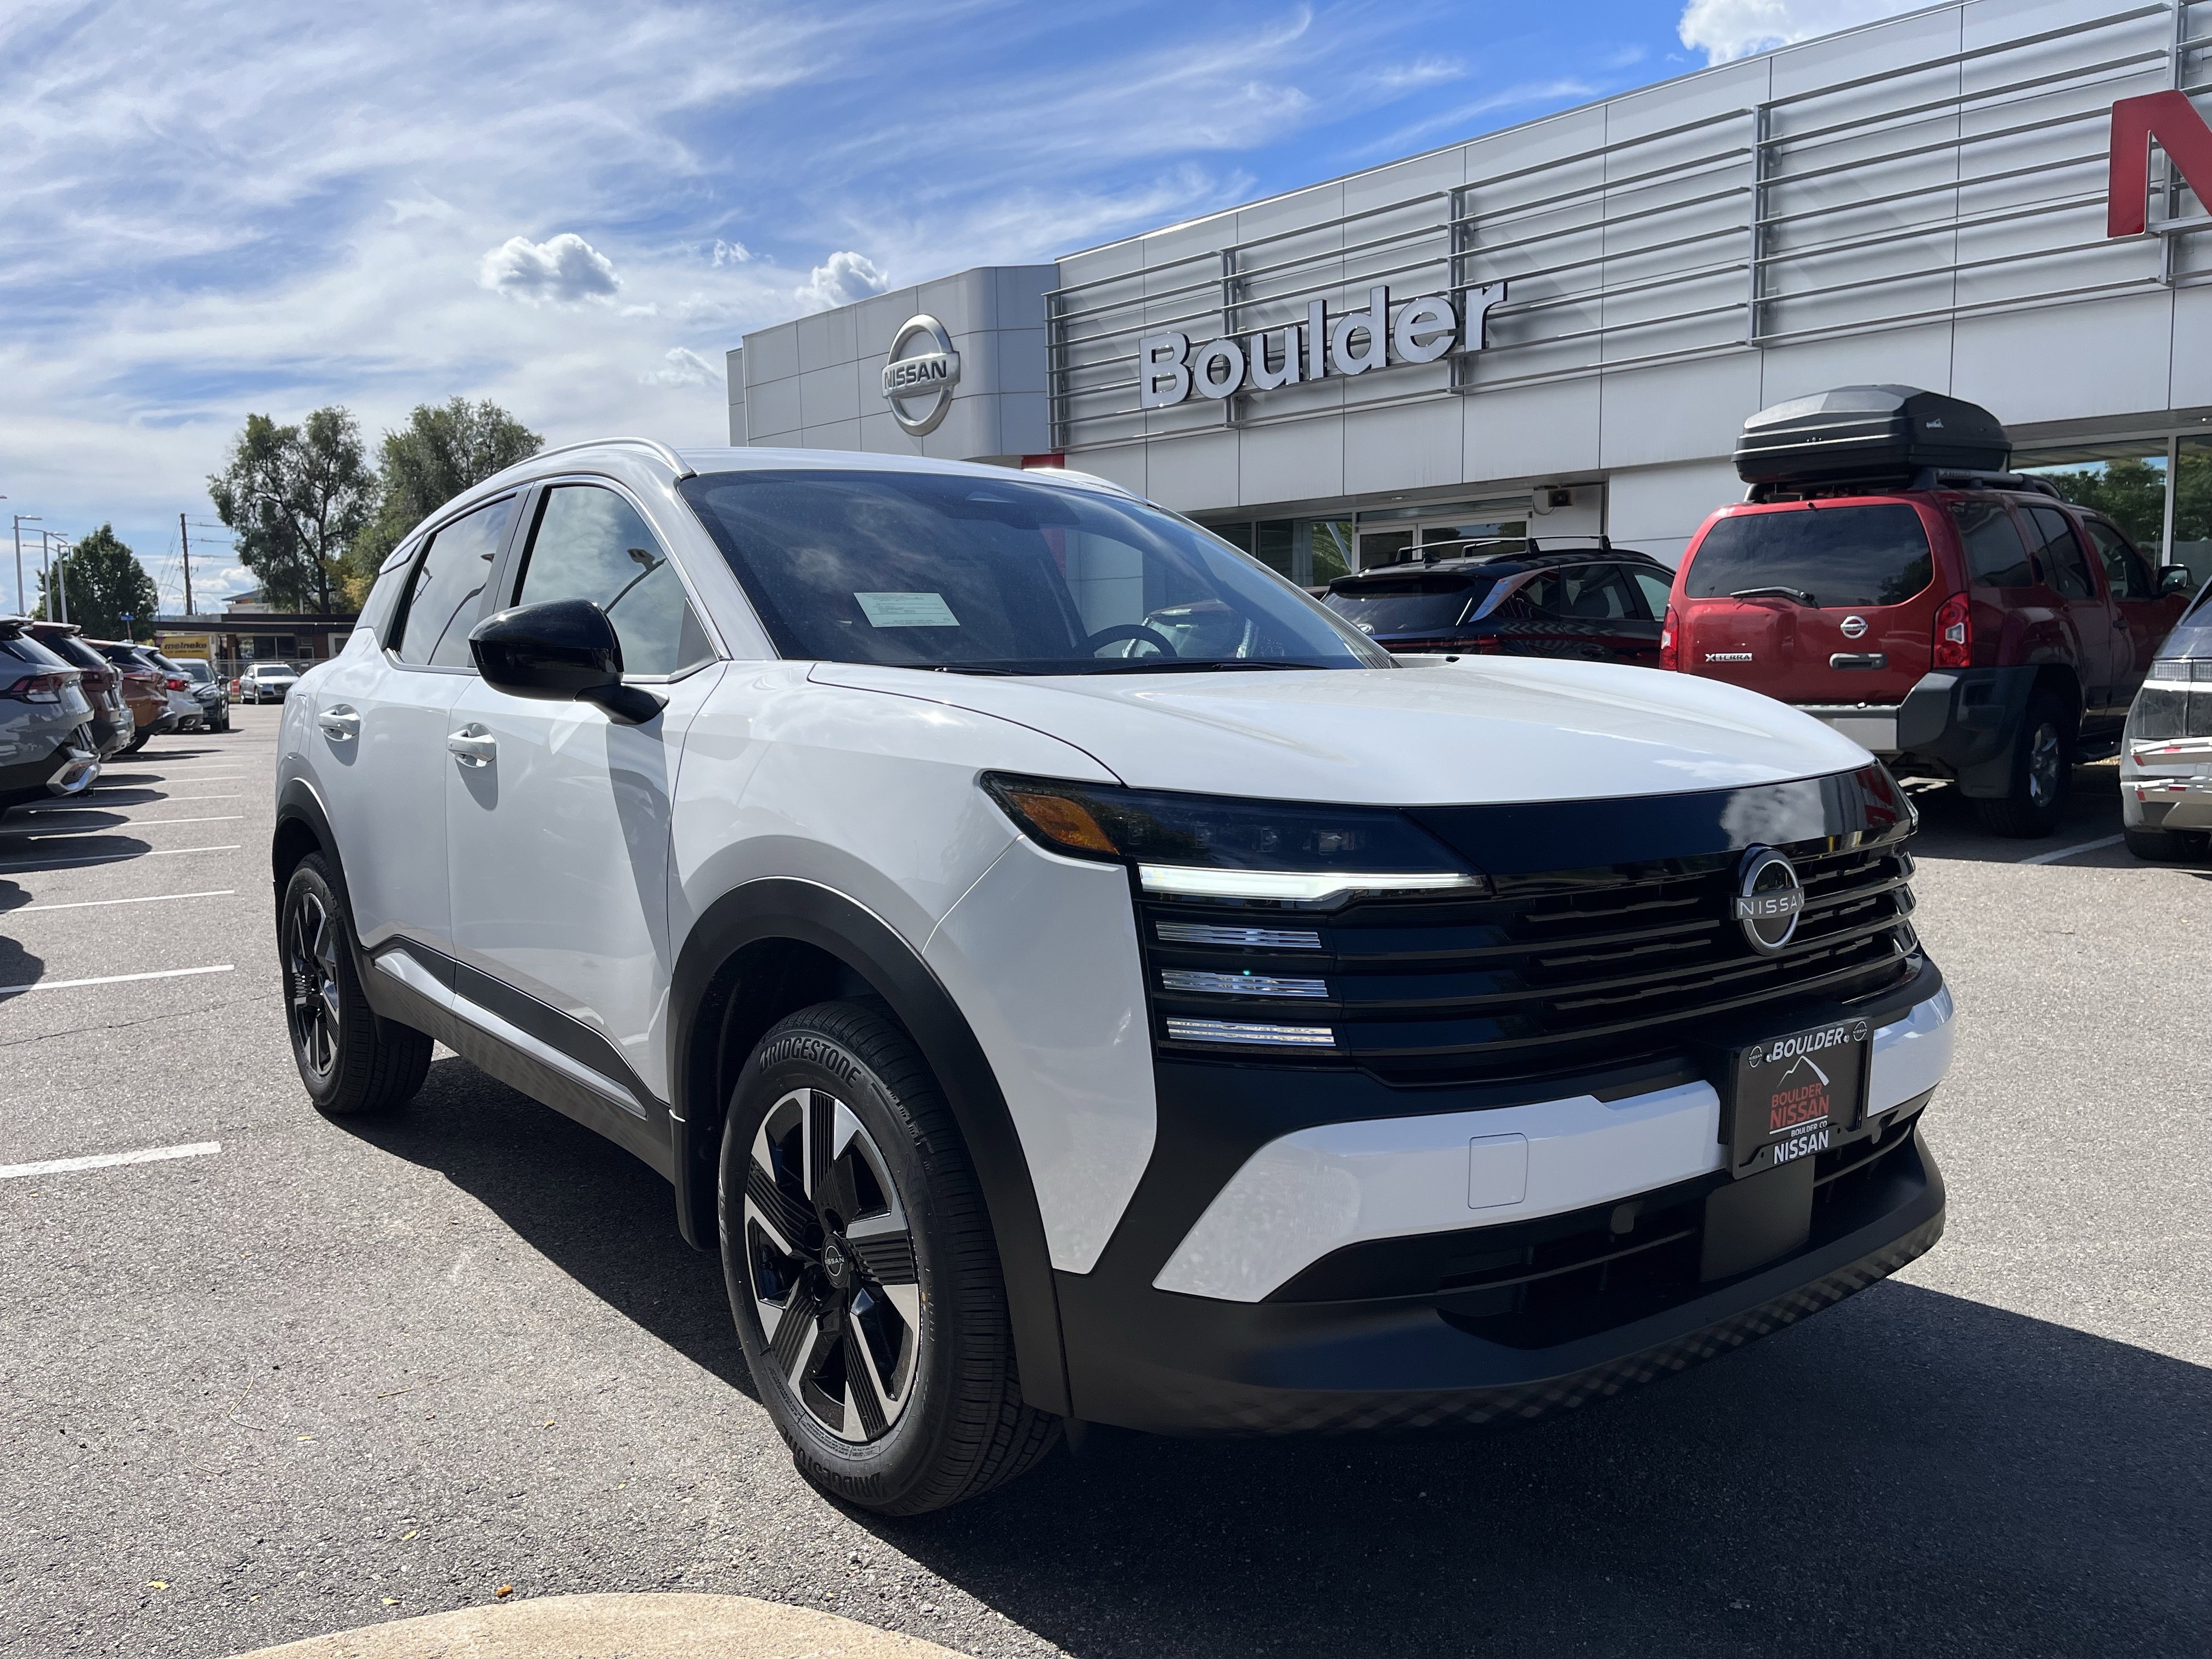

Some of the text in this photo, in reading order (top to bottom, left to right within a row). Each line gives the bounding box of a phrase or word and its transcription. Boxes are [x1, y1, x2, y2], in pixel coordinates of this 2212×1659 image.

[1139, 281, 1508, 409] Boulder
[884, 359, 946, 390] NISSAN
[1740, 890, 1804, 916] NISSAN
[1772, 1027, 1844, 1060] BOULDER
[759, 1037, 861, 1088] BRIDGESTONE
[1771, 1082, 1822, 1108] BOULDER
[1770, 1094, 1830, 1130] NISSAN
[1791, 1120, 1827, 1137] BOULDER CO
[1774, 1130, 1829, 1164] NISSAN
